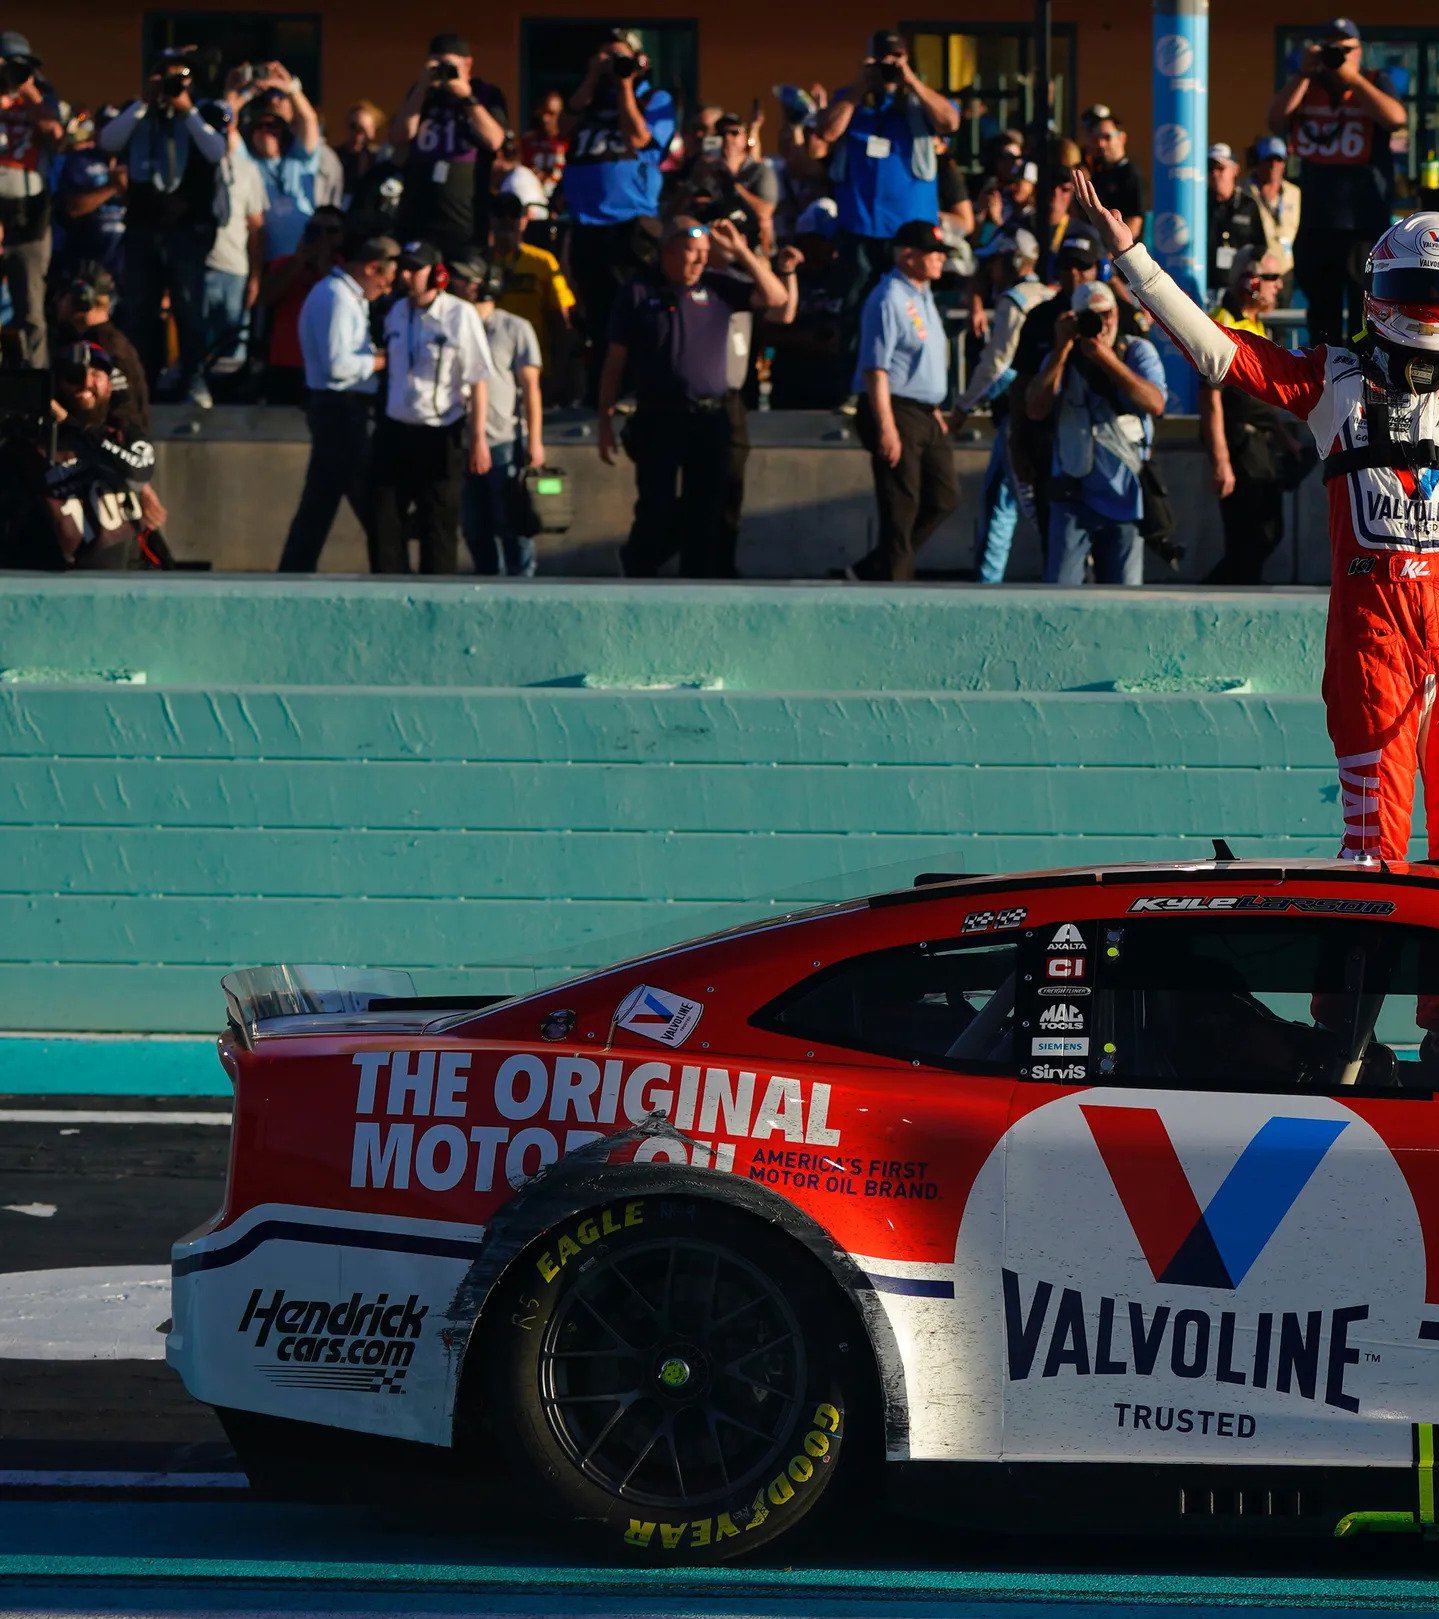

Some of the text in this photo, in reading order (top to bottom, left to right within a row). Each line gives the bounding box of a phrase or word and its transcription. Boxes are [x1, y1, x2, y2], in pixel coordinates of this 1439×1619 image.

[660, 1002, 694, 1041] VALVOLINE
[1039, 1003, 1084, 1022] MAC
[1039, 1022, 1084, 1030] TOOLS
[1038, 1043, 1083, 1051] SIEMENS
[351, 1051, 842, 1149] THE ORIGINAL
[749, 1166, 820, 1190] MOTOR
[825, 1176, 857, 1196] OIL
[868, 1160, 929, 1179] FIRST
[536, 1200, 644, 1284] EAGLE
[238, 1288, 430, 1347] Hendrick
[276, 1336, 416, 1367] cars.com
[1002, 1268, 1370, 1414] VALVOLINE
[1113, 1401, 1257, 1439] TRUSTED
[623, 1402, 840, 1550] GOODYEAR
